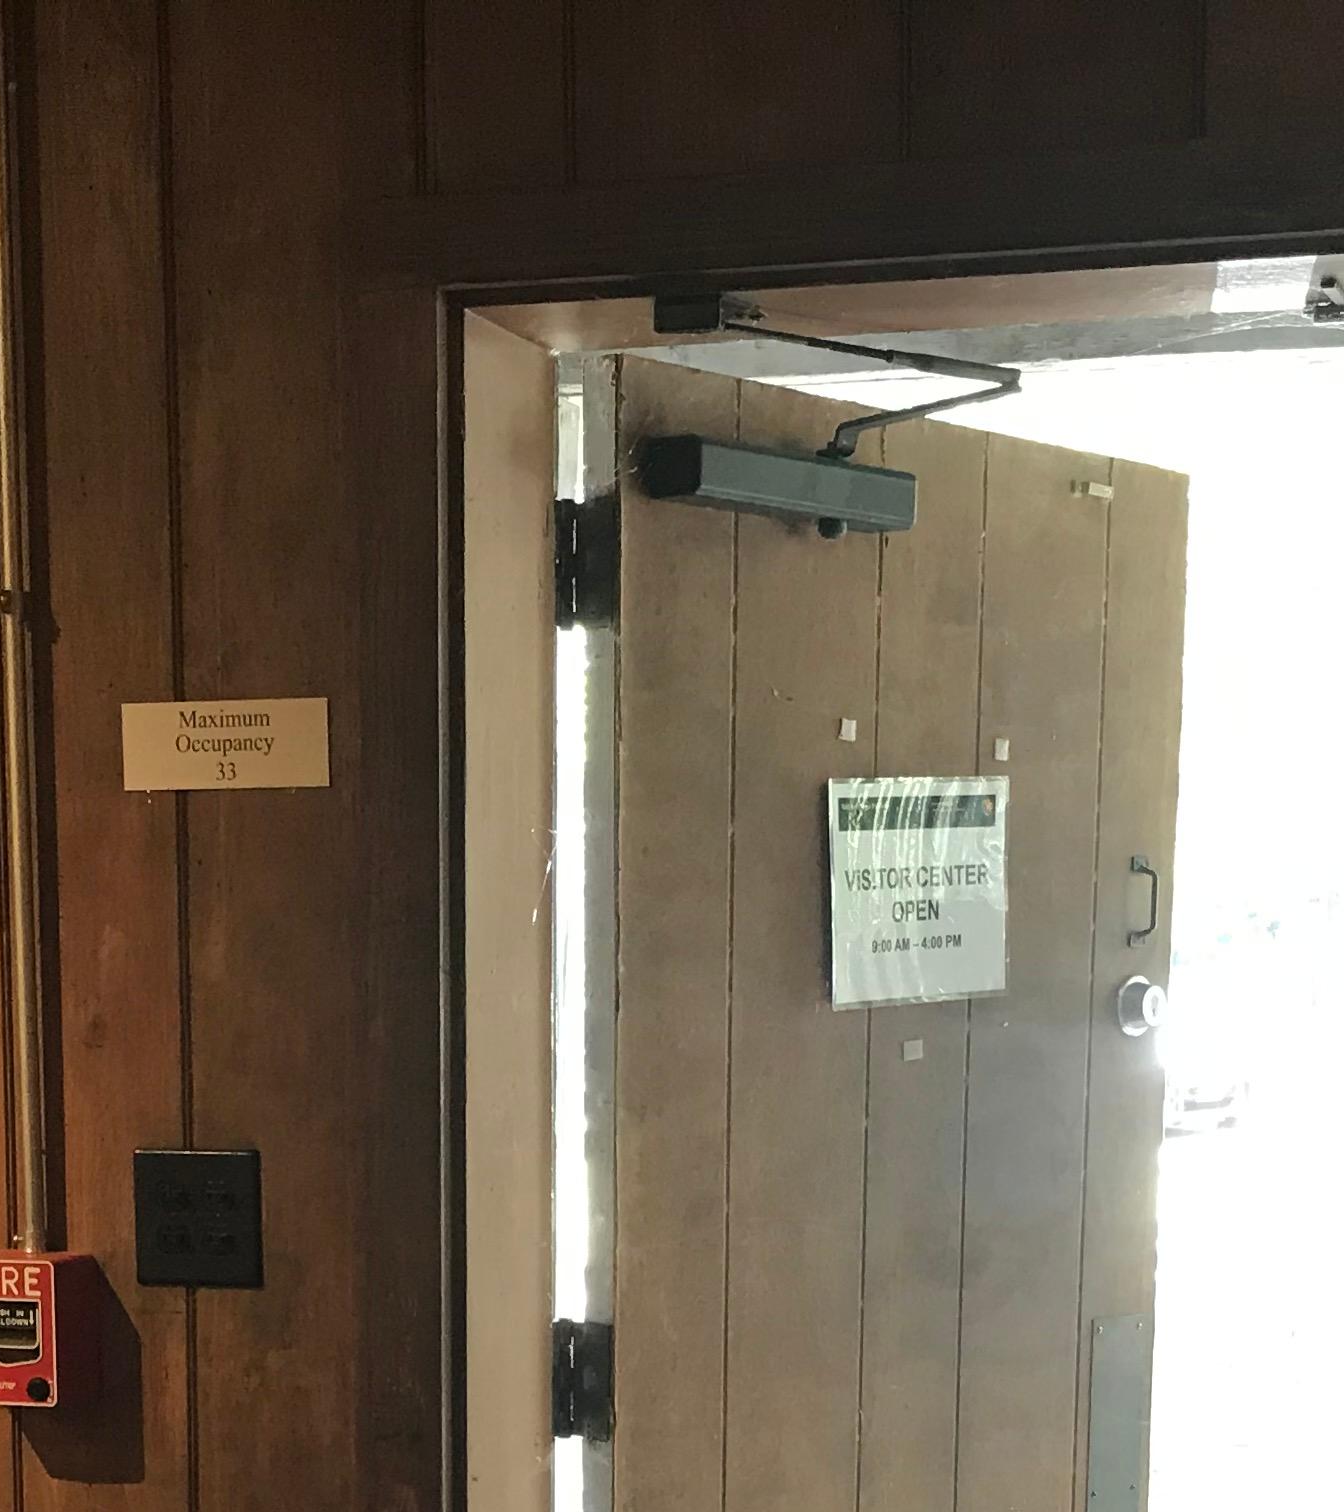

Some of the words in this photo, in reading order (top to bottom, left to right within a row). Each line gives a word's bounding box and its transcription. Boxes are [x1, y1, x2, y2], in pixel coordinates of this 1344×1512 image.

[179, 709, 270, 729] Maximum
[176, 735, 274, 756] Occupancy
[216, 762, 237, 781] 33
[917, 864, 990, 887] CENTER
[892, 899, 940, 922] OPEN
[895, 938, 910, 953] AM
[946, 934, 962, 949] PM
